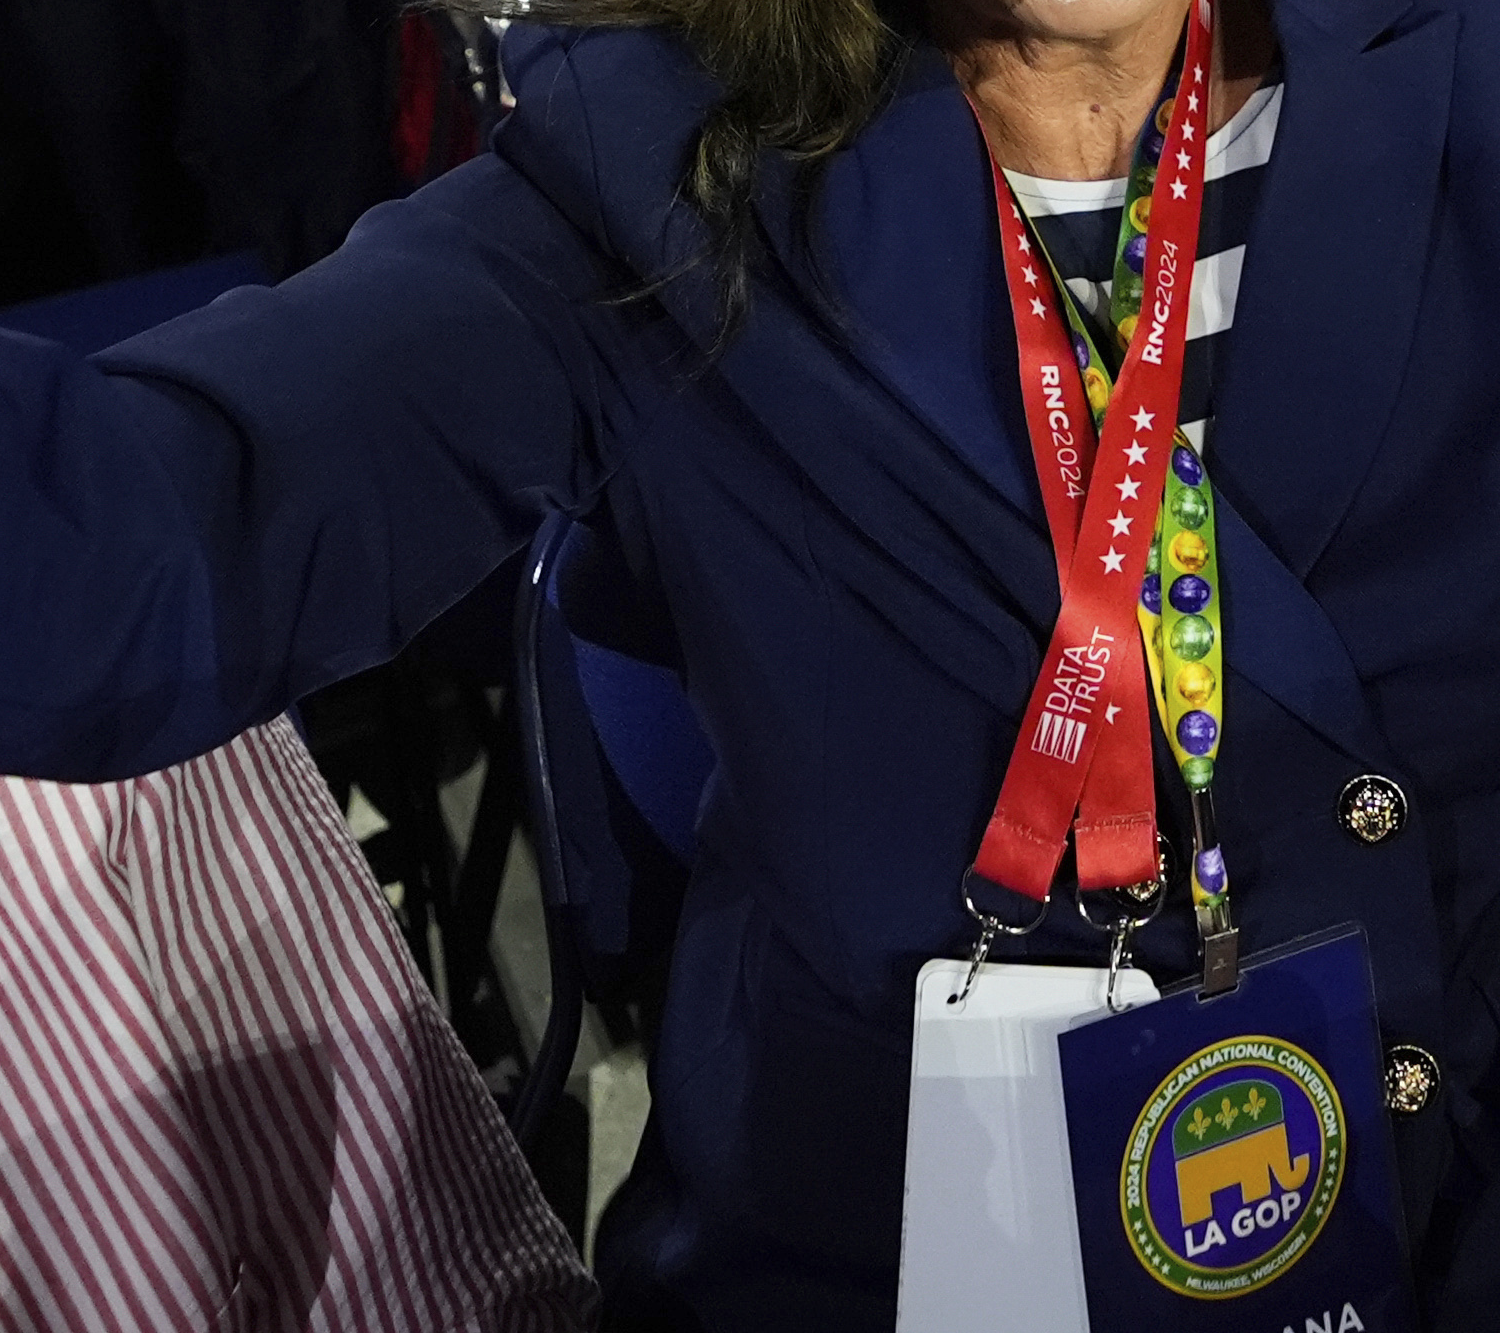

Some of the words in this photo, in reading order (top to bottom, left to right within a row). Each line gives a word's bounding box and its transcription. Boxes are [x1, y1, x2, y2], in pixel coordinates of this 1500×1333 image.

[1141, 239, 1179, 366] RNC2024
[1040, 365, 1086, 500] RNC2024
[1045, 645, 1088, 713] DATA
[1068, 625, 1115, 714] TRUST
[1199, 1043, 1276, 1072] NATIONAL
[1277, 1050, 1339, 1138] CONVENTION
[1131, 1062, 1199, 1162] REPUBLICAN
[1128, 1160, 1142, 1208] 2024
[1183, 1219, 1228, 1258] LA
[1231, 1191, 1301, 1238] GOP
